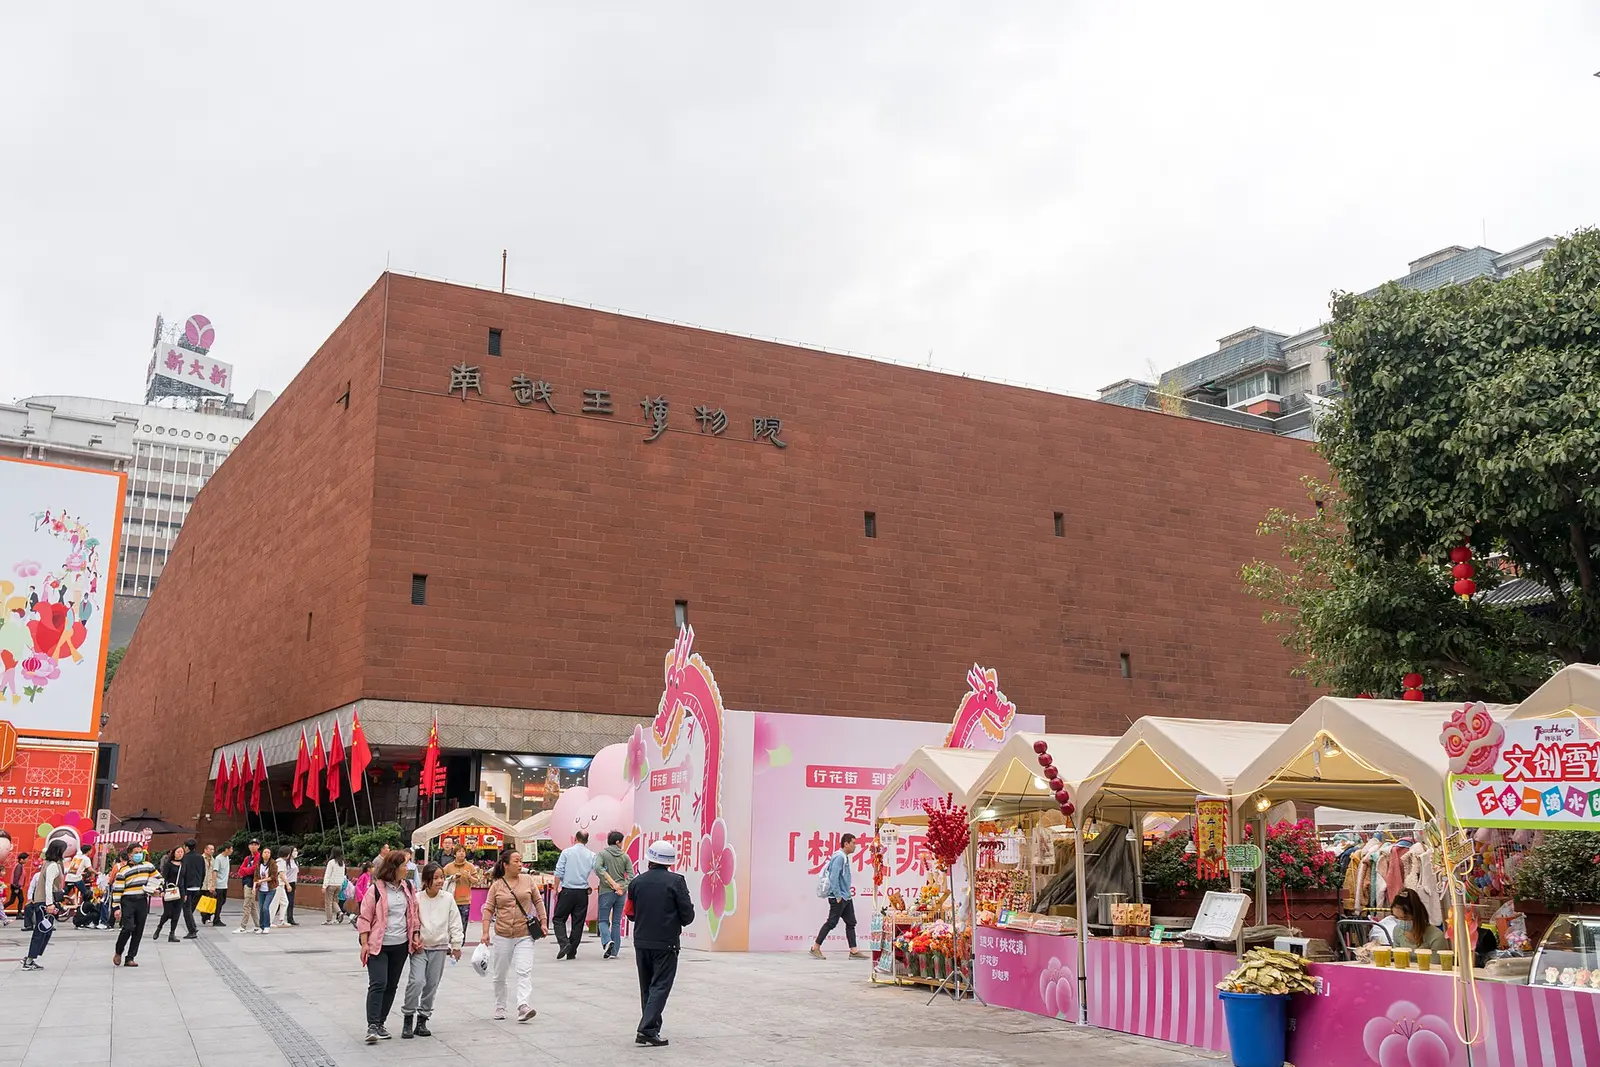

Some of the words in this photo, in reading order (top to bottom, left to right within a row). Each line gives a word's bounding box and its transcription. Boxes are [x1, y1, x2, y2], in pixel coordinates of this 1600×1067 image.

[164, 349, 228, 389] 新大新
[448, 361, 788, 448] 南越王博物院
[813, 770, 858, 784] 行花街
[1505, 746, 1600, 779] 文创雪
[660, 794, 681, 824] 遇见
[844, 795, 871, 825] 遇
[979, 935, 1028, 957] 遇见「桃花源」
